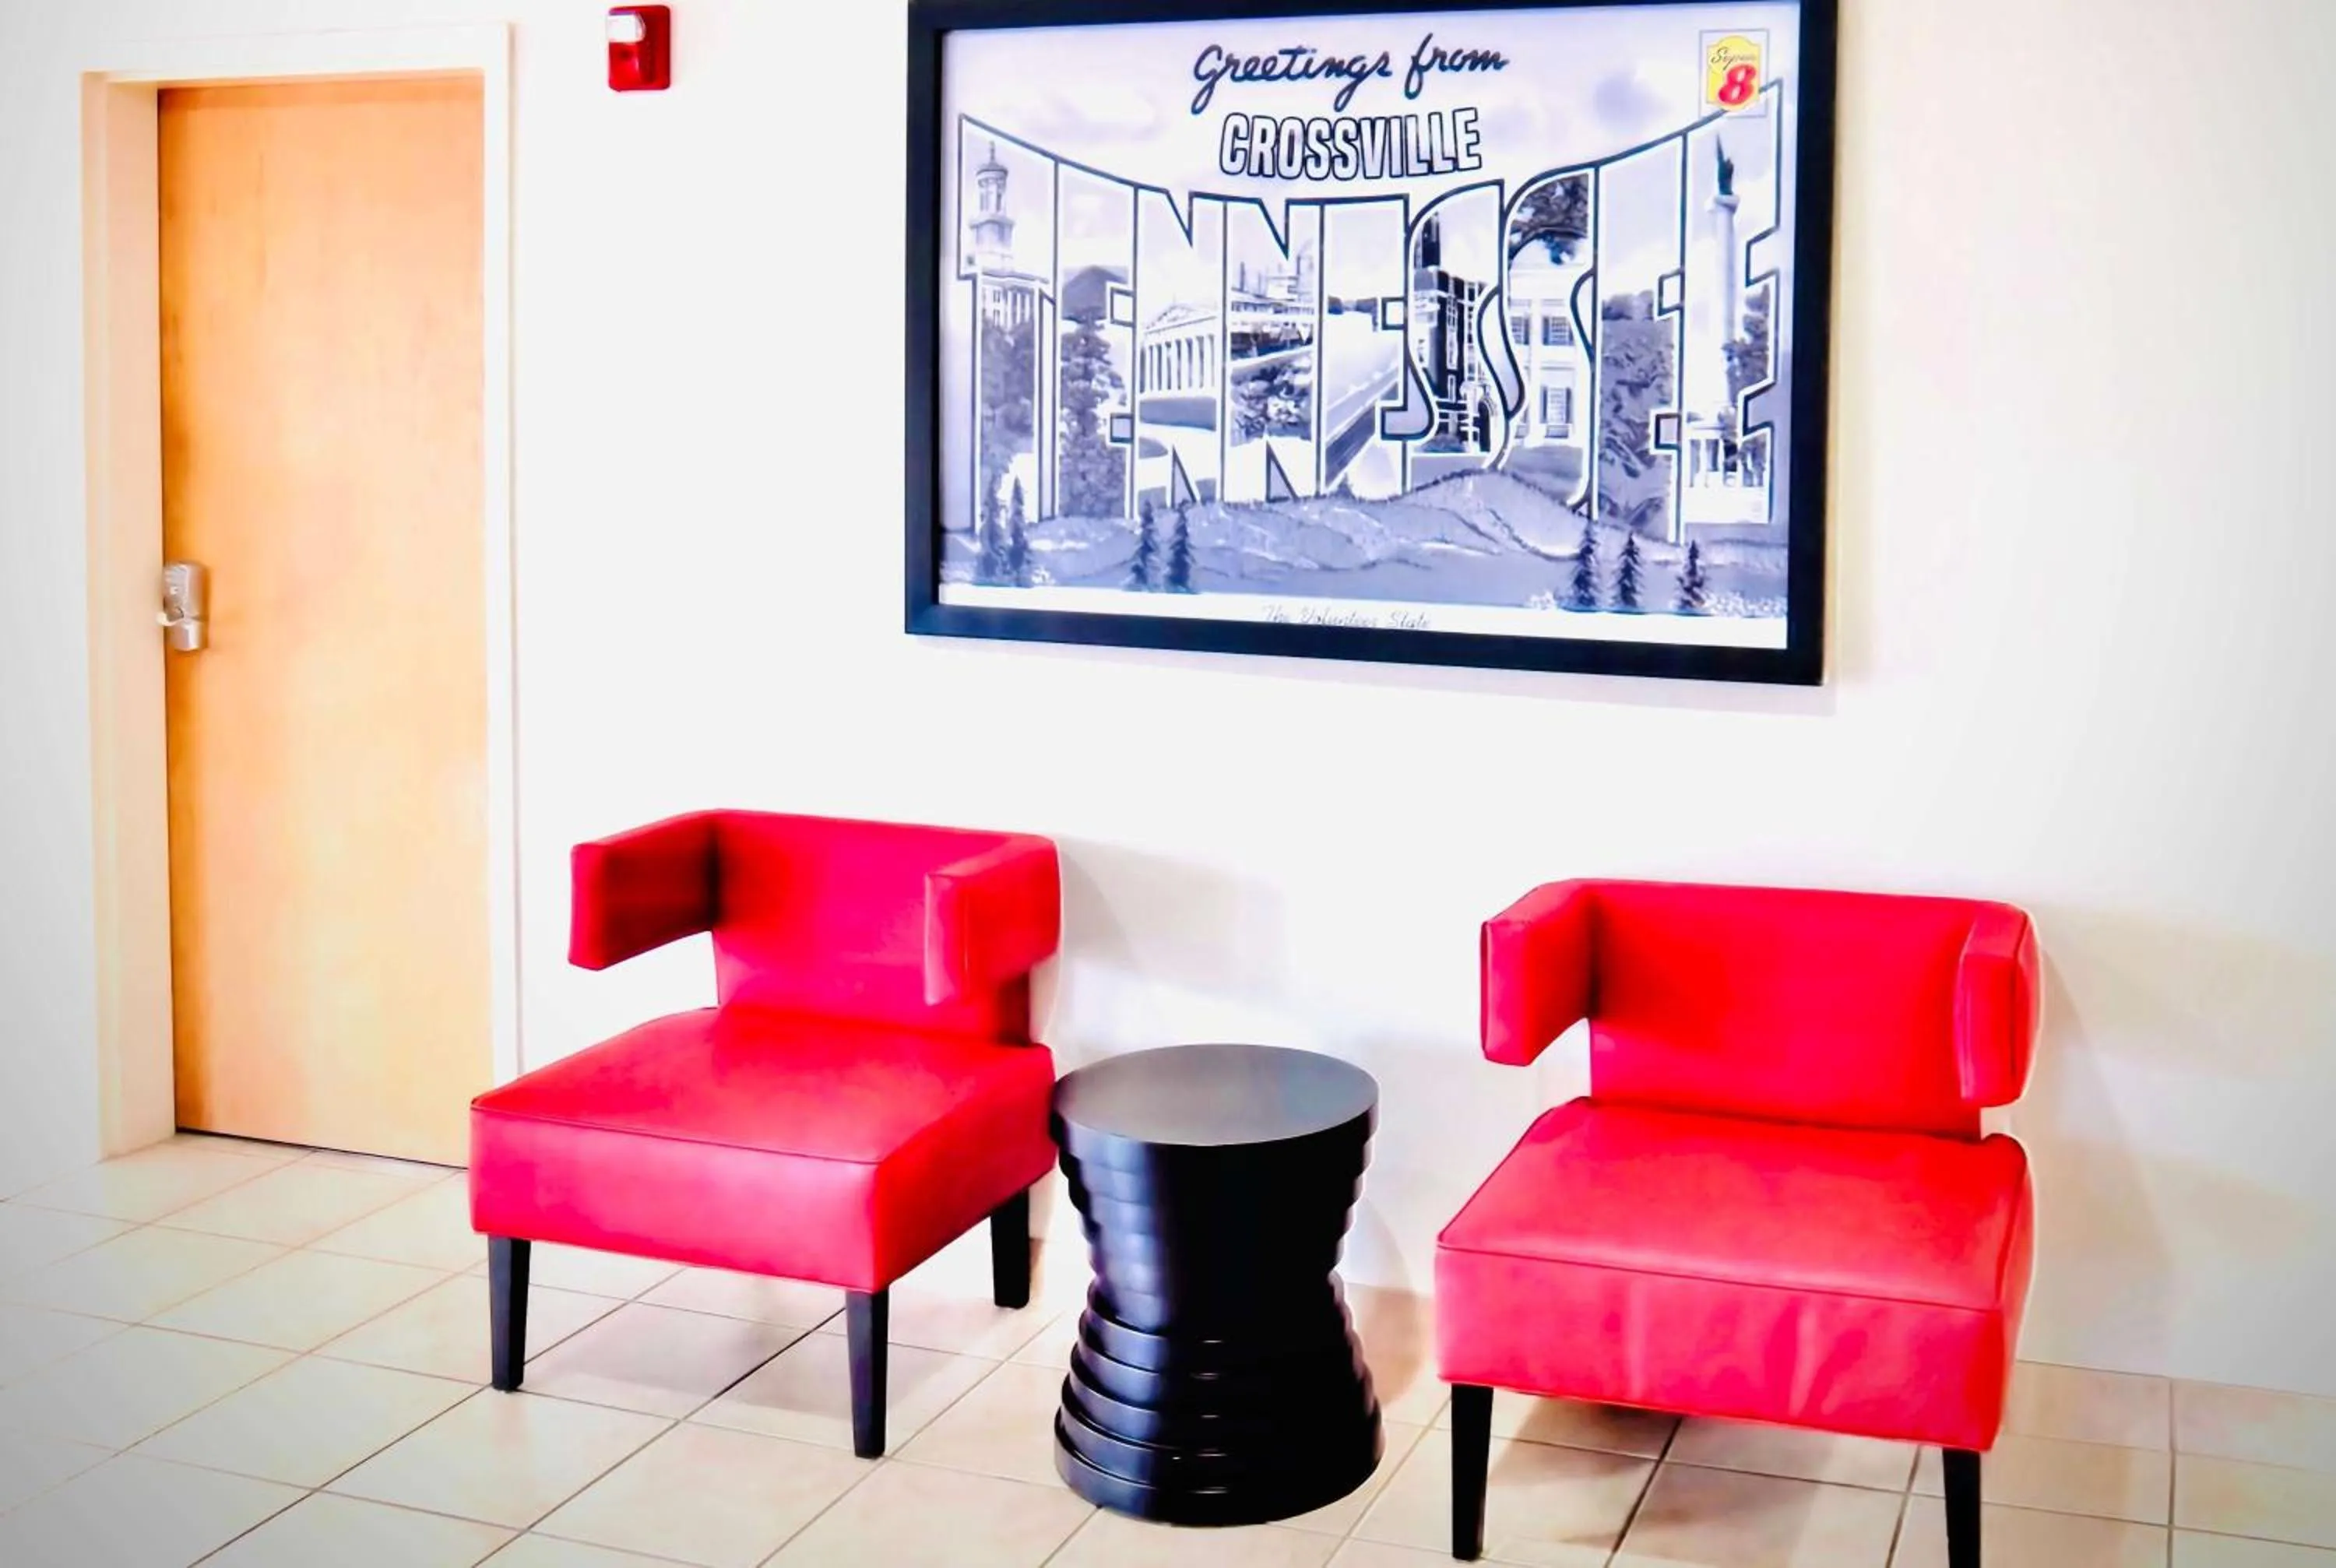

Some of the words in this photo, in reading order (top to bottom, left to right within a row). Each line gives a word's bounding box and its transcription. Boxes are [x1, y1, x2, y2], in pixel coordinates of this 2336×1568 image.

[1191, 44, 1394, 114] Greetings
[1404, 33, 1511, 100] from
[1718, 64, 1757, 106] 8
[1219, 107, 1483, 181] CROSSVILLE
[956, 77, 1783, 547] TENNESSEE
